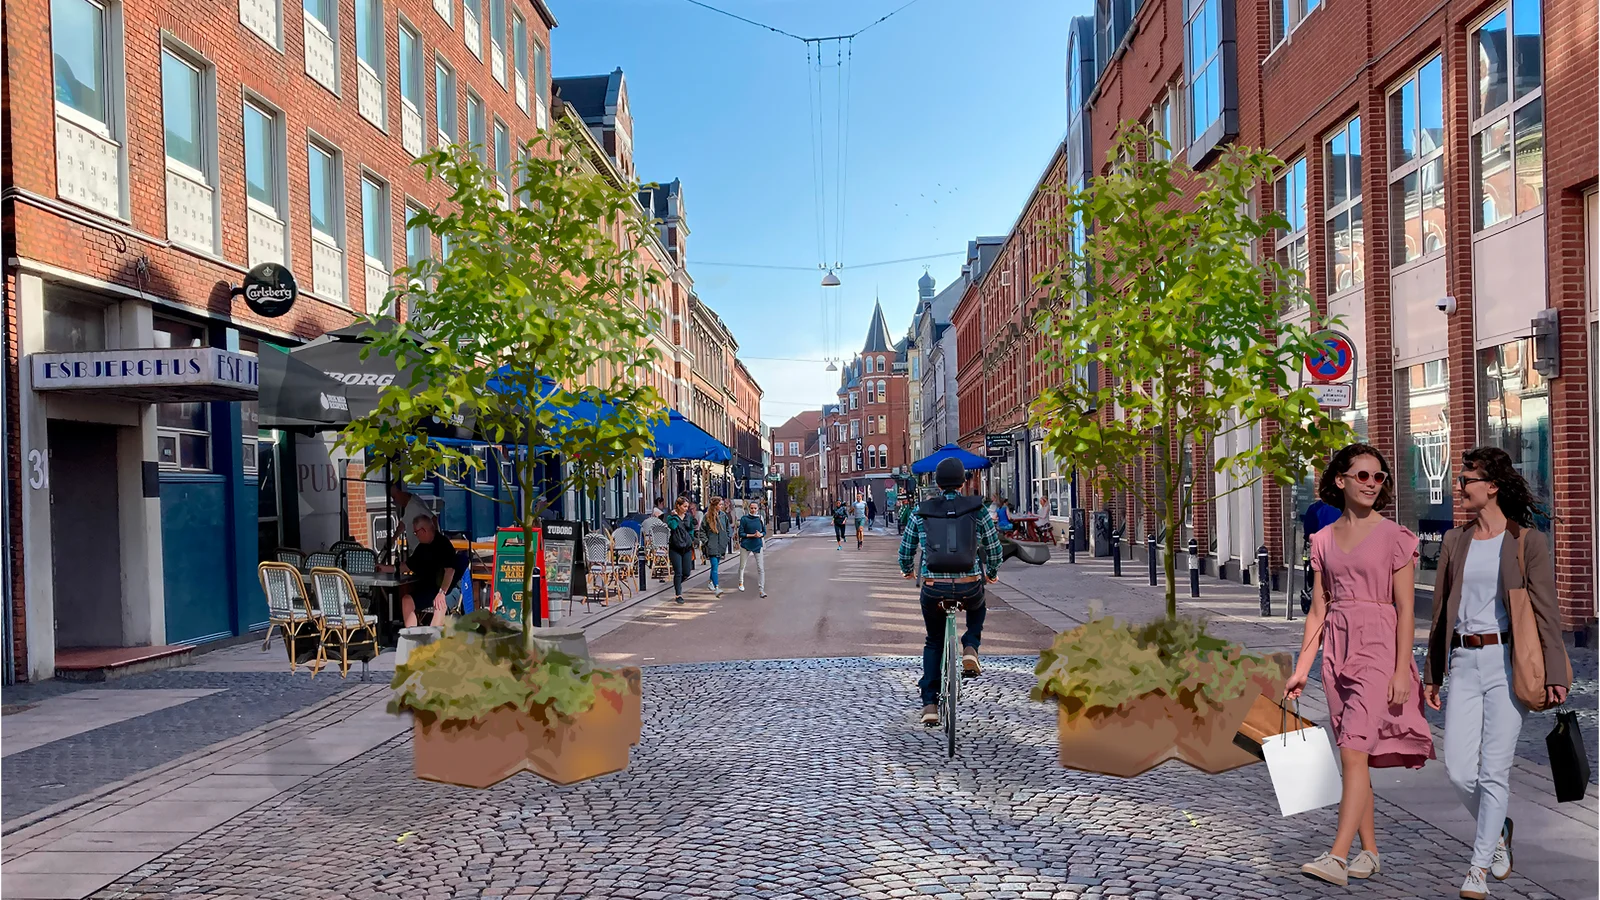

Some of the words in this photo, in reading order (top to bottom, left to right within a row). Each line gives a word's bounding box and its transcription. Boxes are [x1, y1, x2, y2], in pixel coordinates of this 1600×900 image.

[246, 284, 292, 304] Carlsberg
[43, 358, 201, 379] ESBJERGHUS
[28, 449, 49, 489] 31
[298, 464, 338, 492] PUB
[547, 525, 573, 535] TUBORG
